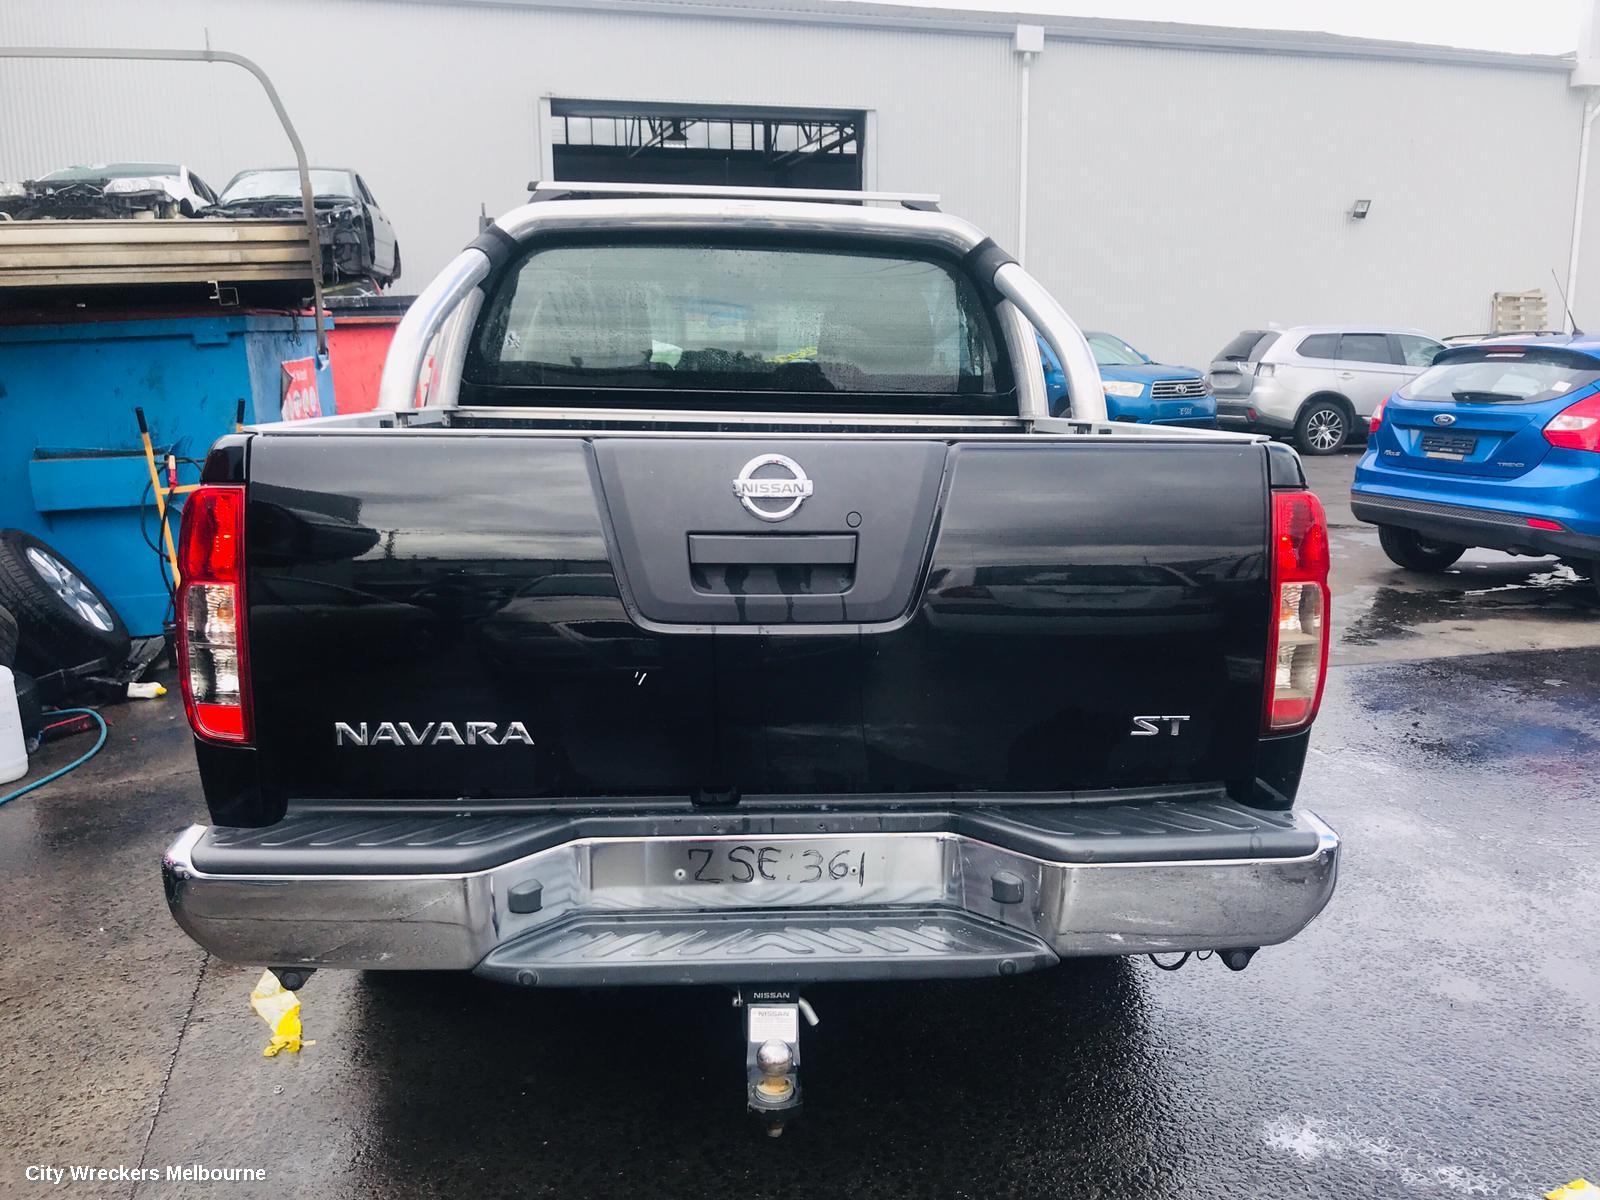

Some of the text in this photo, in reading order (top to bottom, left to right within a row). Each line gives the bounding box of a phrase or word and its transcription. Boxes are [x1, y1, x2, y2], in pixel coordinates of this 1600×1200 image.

[742, 483, 804, 493] NISSAN
[334, 721, 535, 746] NAVARA
[1130, 715, 1191, 736] ST
